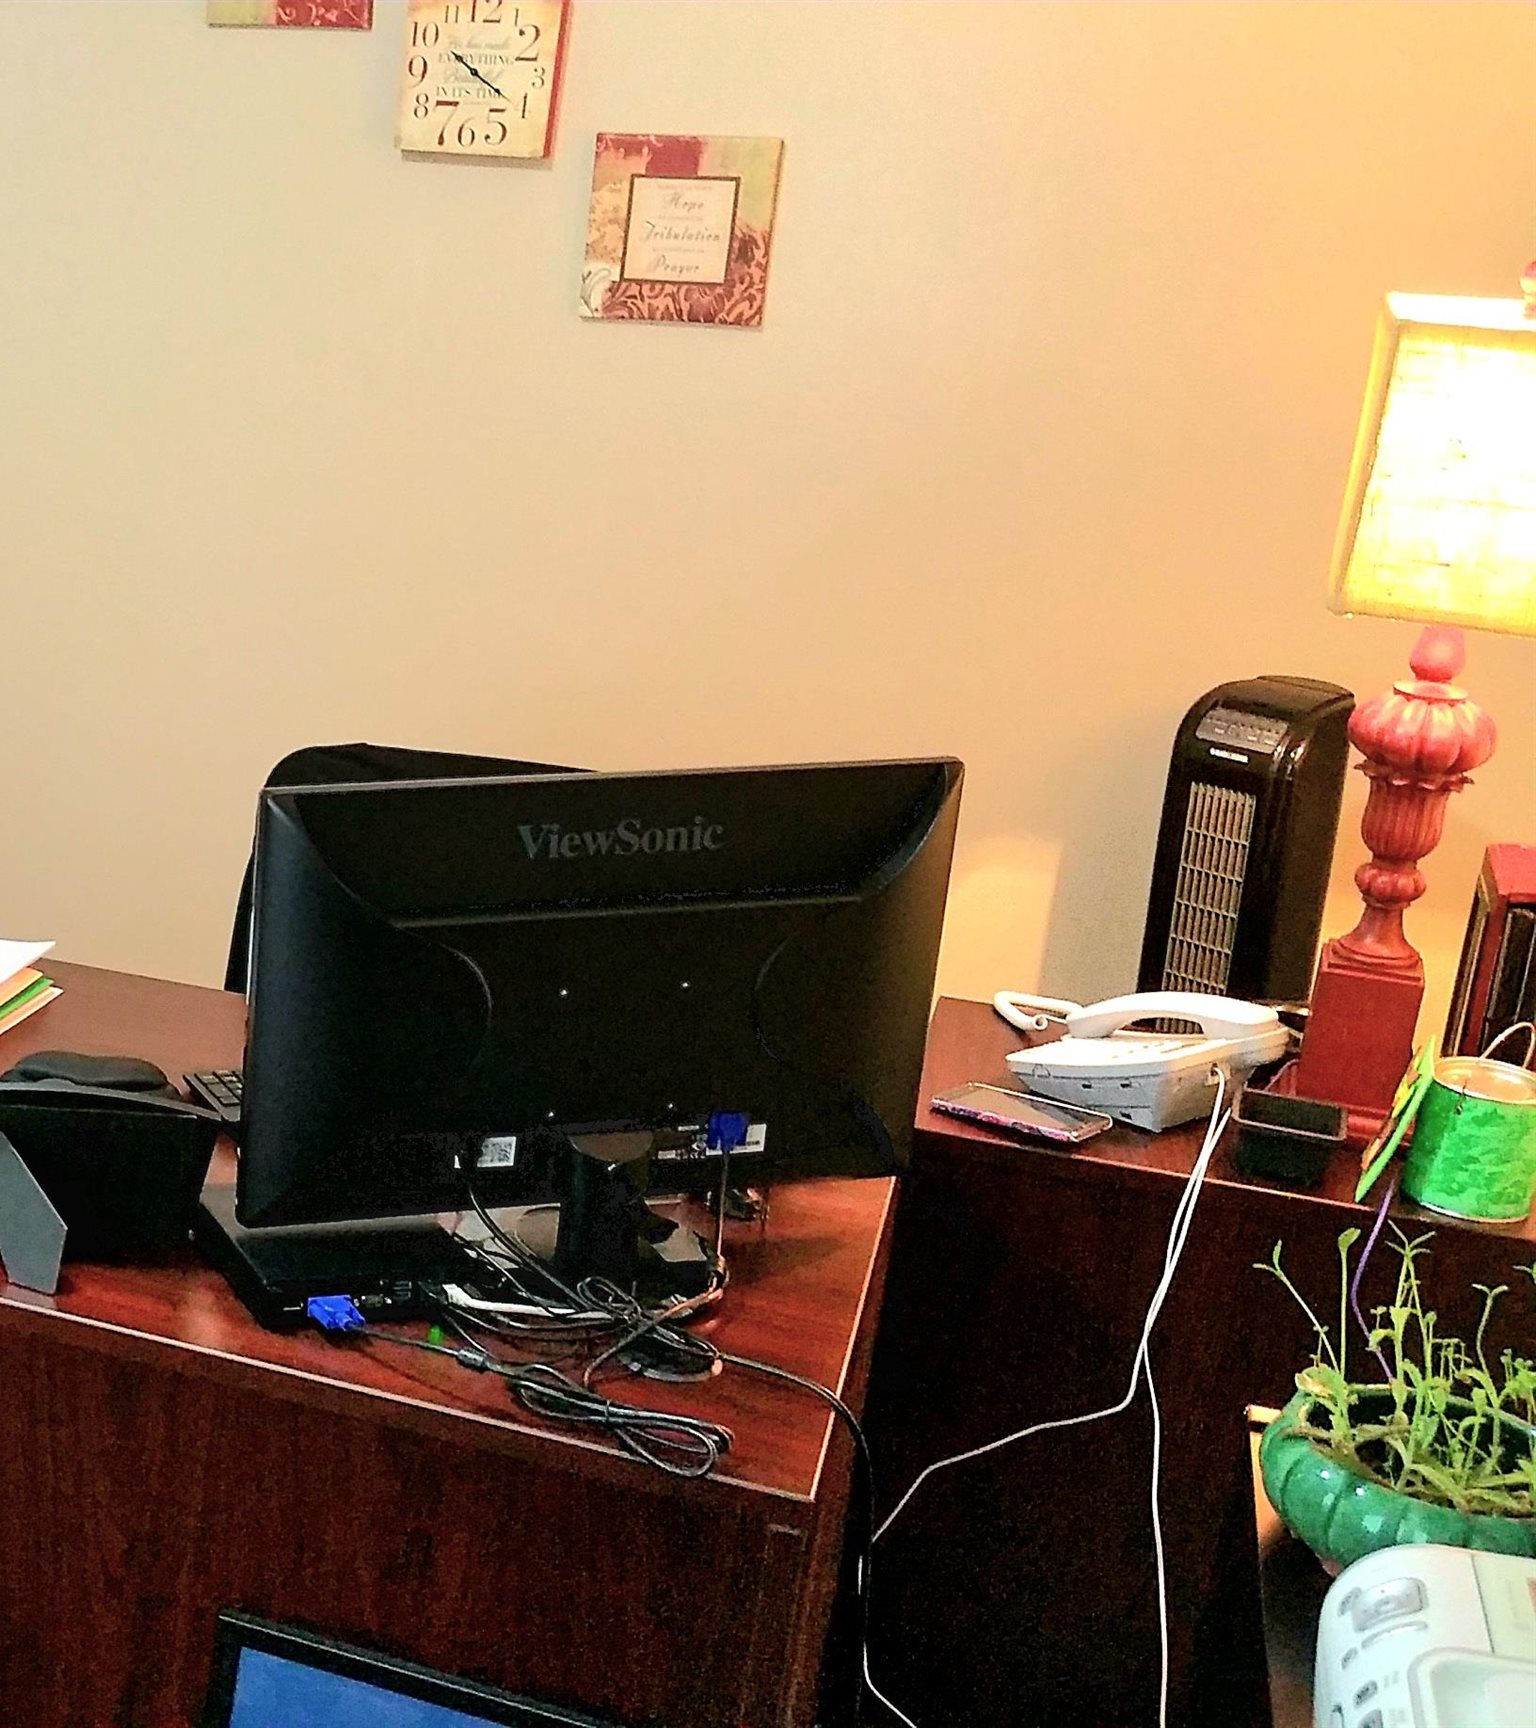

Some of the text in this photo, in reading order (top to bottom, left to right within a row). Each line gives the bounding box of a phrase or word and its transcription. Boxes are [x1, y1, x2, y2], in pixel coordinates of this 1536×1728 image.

[470, 0, 503, 23] 12
[412, 21, 440, 48] 10
[514, 24, 541, 62] 2
[408, 55, 428, 88] 9
[438, 53, 514, 65] EVRYTHING
[531, 66, 546, 88] 3
[414, 93, 429, 119] 8
[433, 100, 508, 147] 7 6 5
[640, 219, 721, 242] Tribulation
[517, 816, 724, 859] ViewSonic
